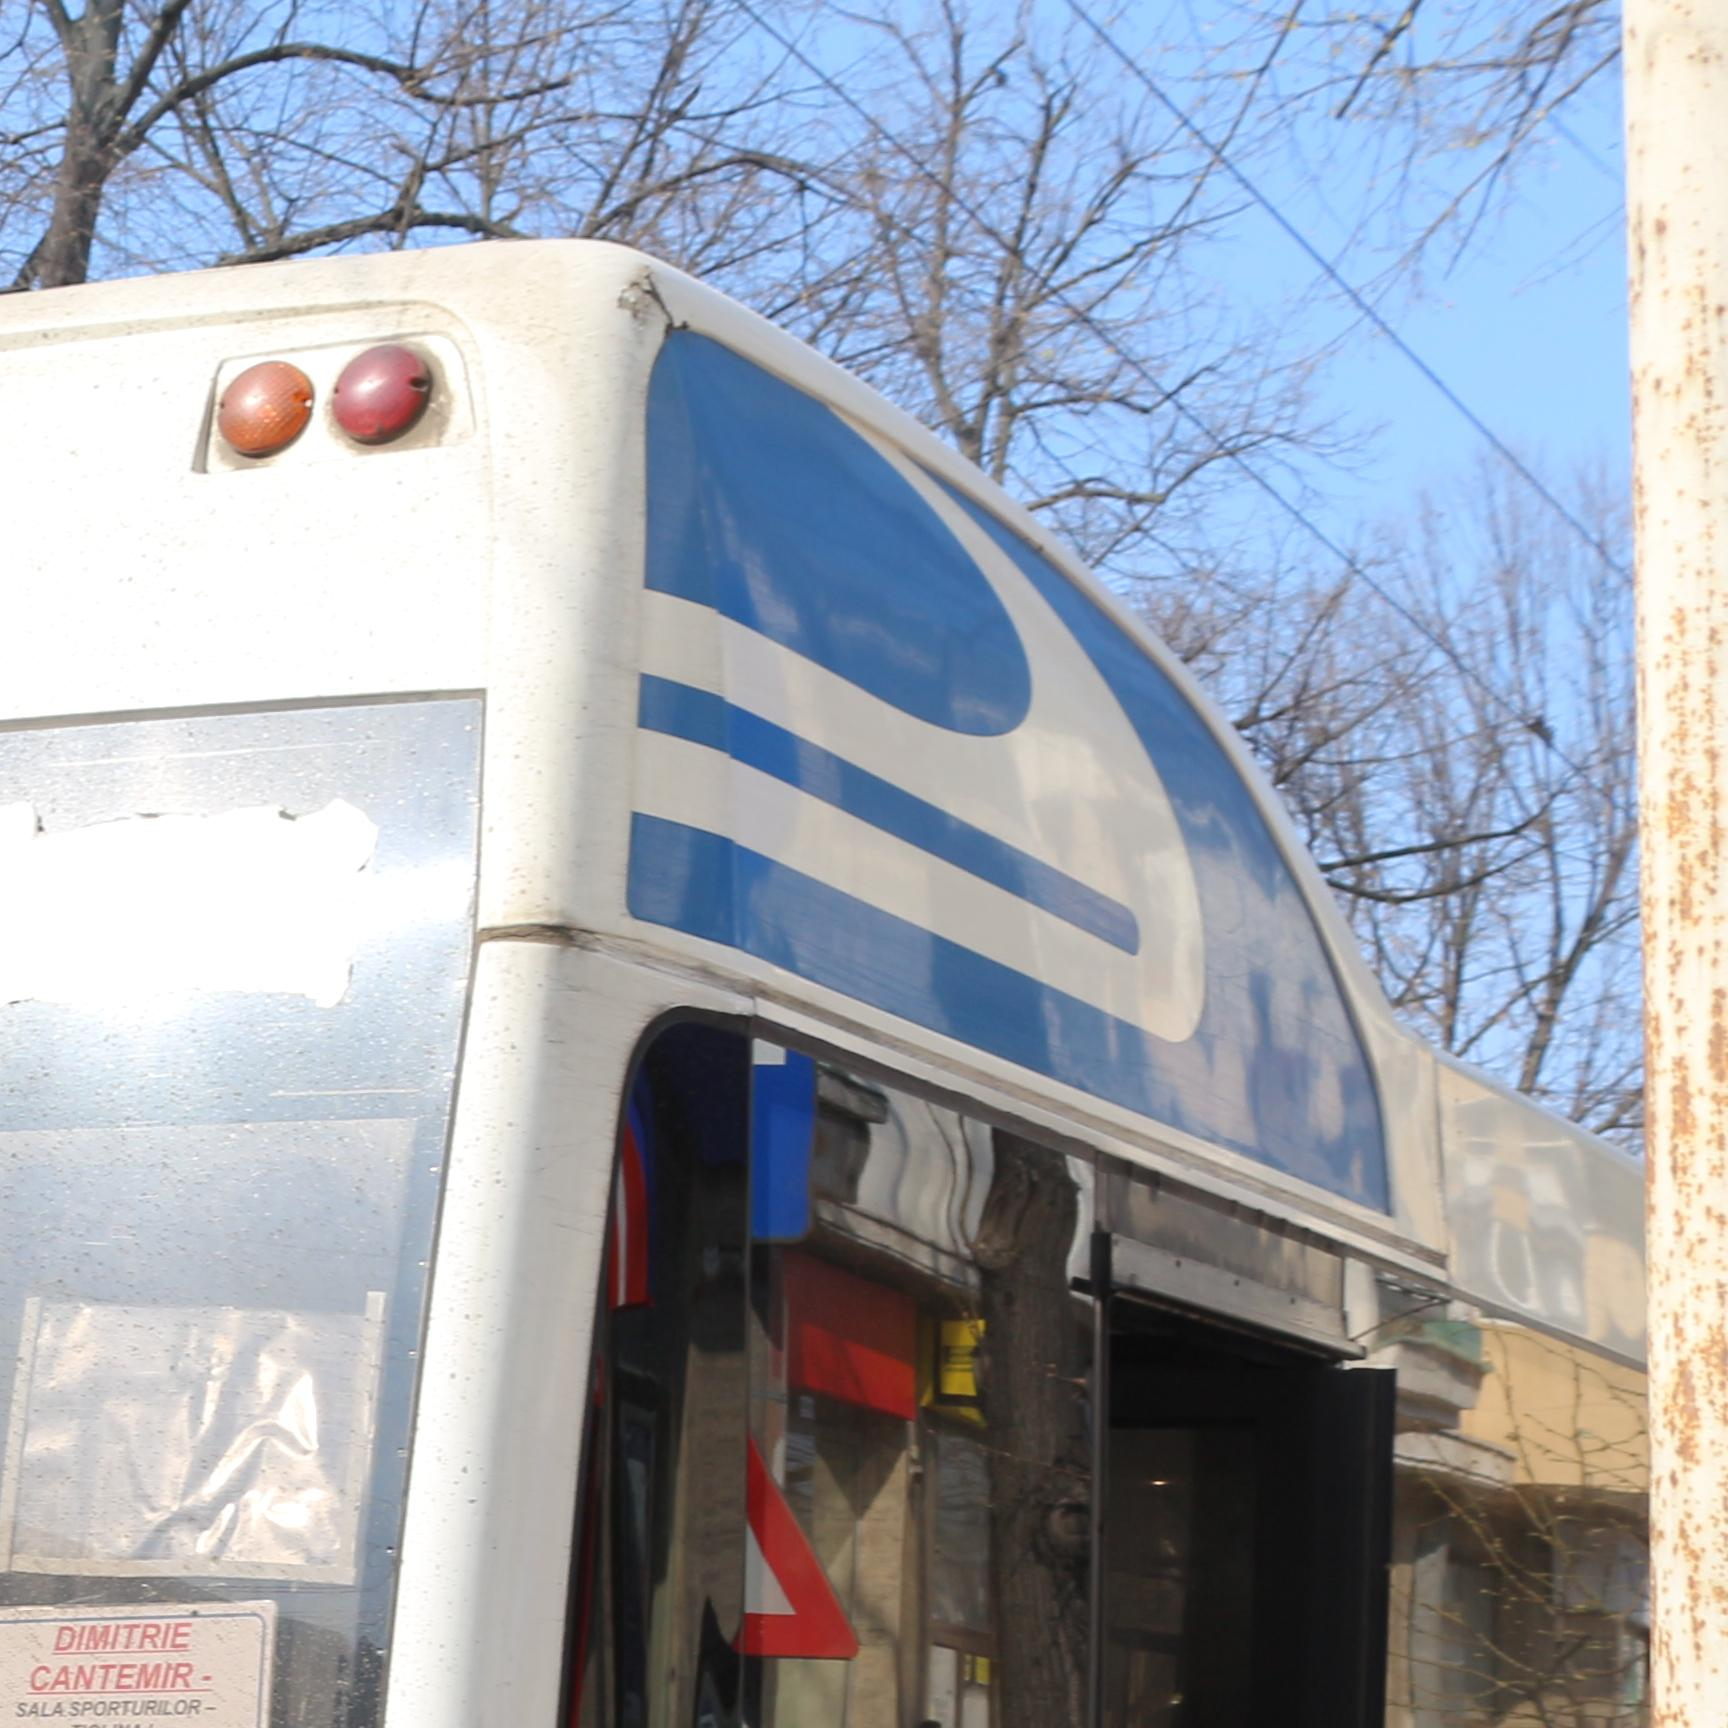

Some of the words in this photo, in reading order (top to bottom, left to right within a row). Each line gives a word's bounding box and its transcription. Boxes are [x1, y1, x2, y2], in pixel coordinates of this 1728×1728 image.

[53, 1622, 193, 1652] DIMITRIE
[27, 1661, 194, 1693] CANTEMIR
[15, 1702, 64, 1718] SALA
[69, 1700, 201, 1717] SPORTURILOR
